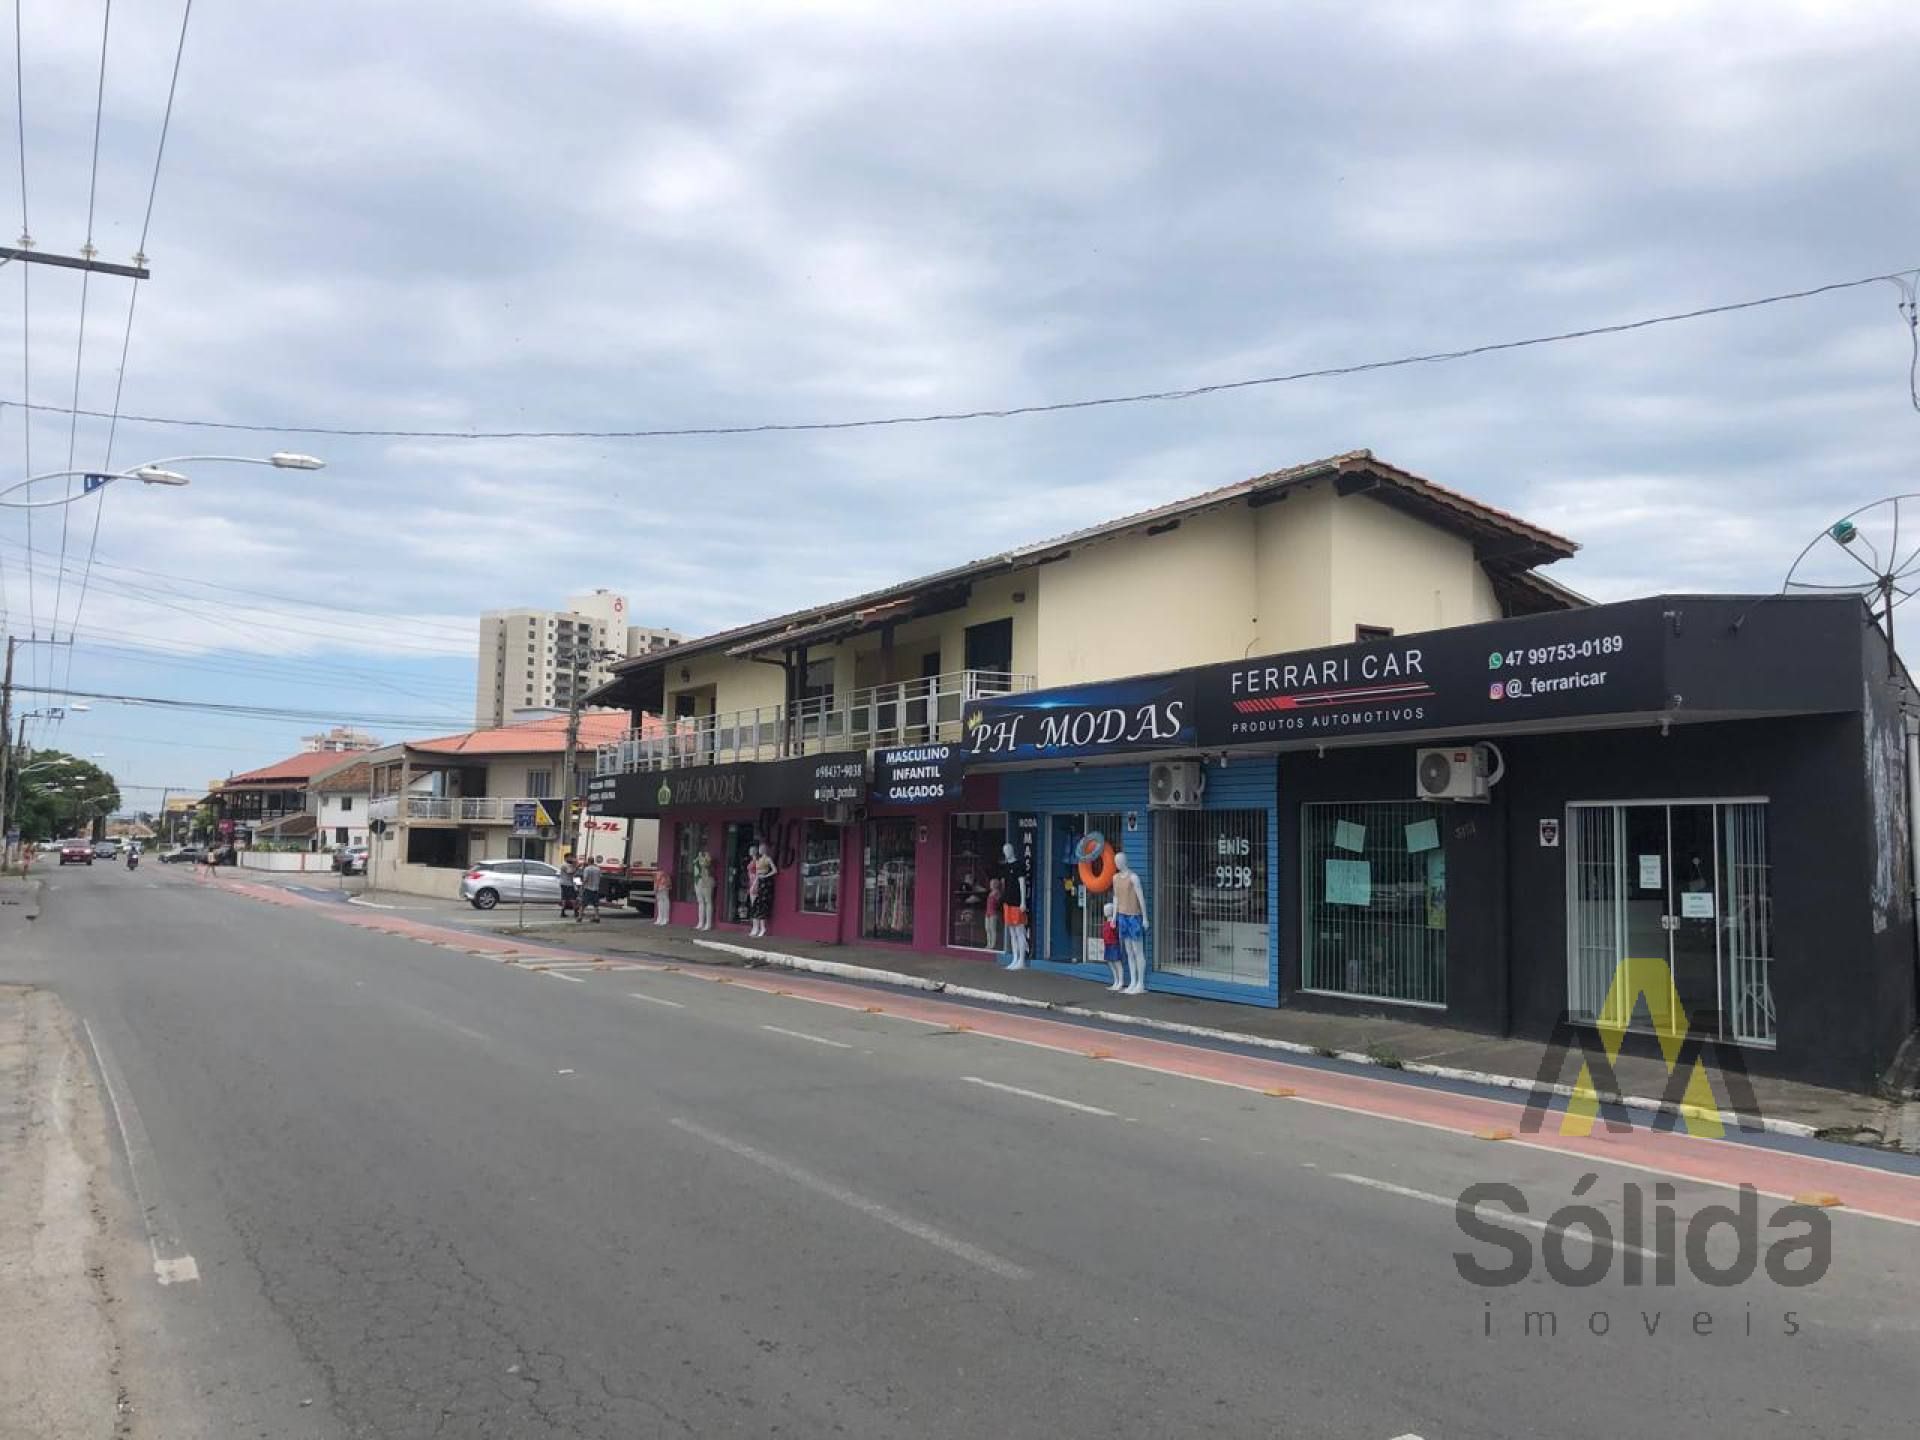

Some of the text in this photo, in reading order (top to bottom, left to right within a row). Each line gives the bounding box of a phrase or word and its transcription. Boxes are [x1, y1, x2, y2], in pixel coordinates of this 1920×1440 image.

[1505, 635, 1623, 666] 47 99753-0189
[1232, 649, 1423, 694] FERRARI CAR
[1505, 671, 1608, 698] @_ferraricar
[970, 701, 1183, 754] PH MODAS
[1232, 707, 1425, 733] PRODUTOS AUTOMOTIVOS
[886, 747, 949, 764] MASCULINO
[892, 765, 941, 781] INFANTIL
[889, 784, 945, 802] CALÇADOS
